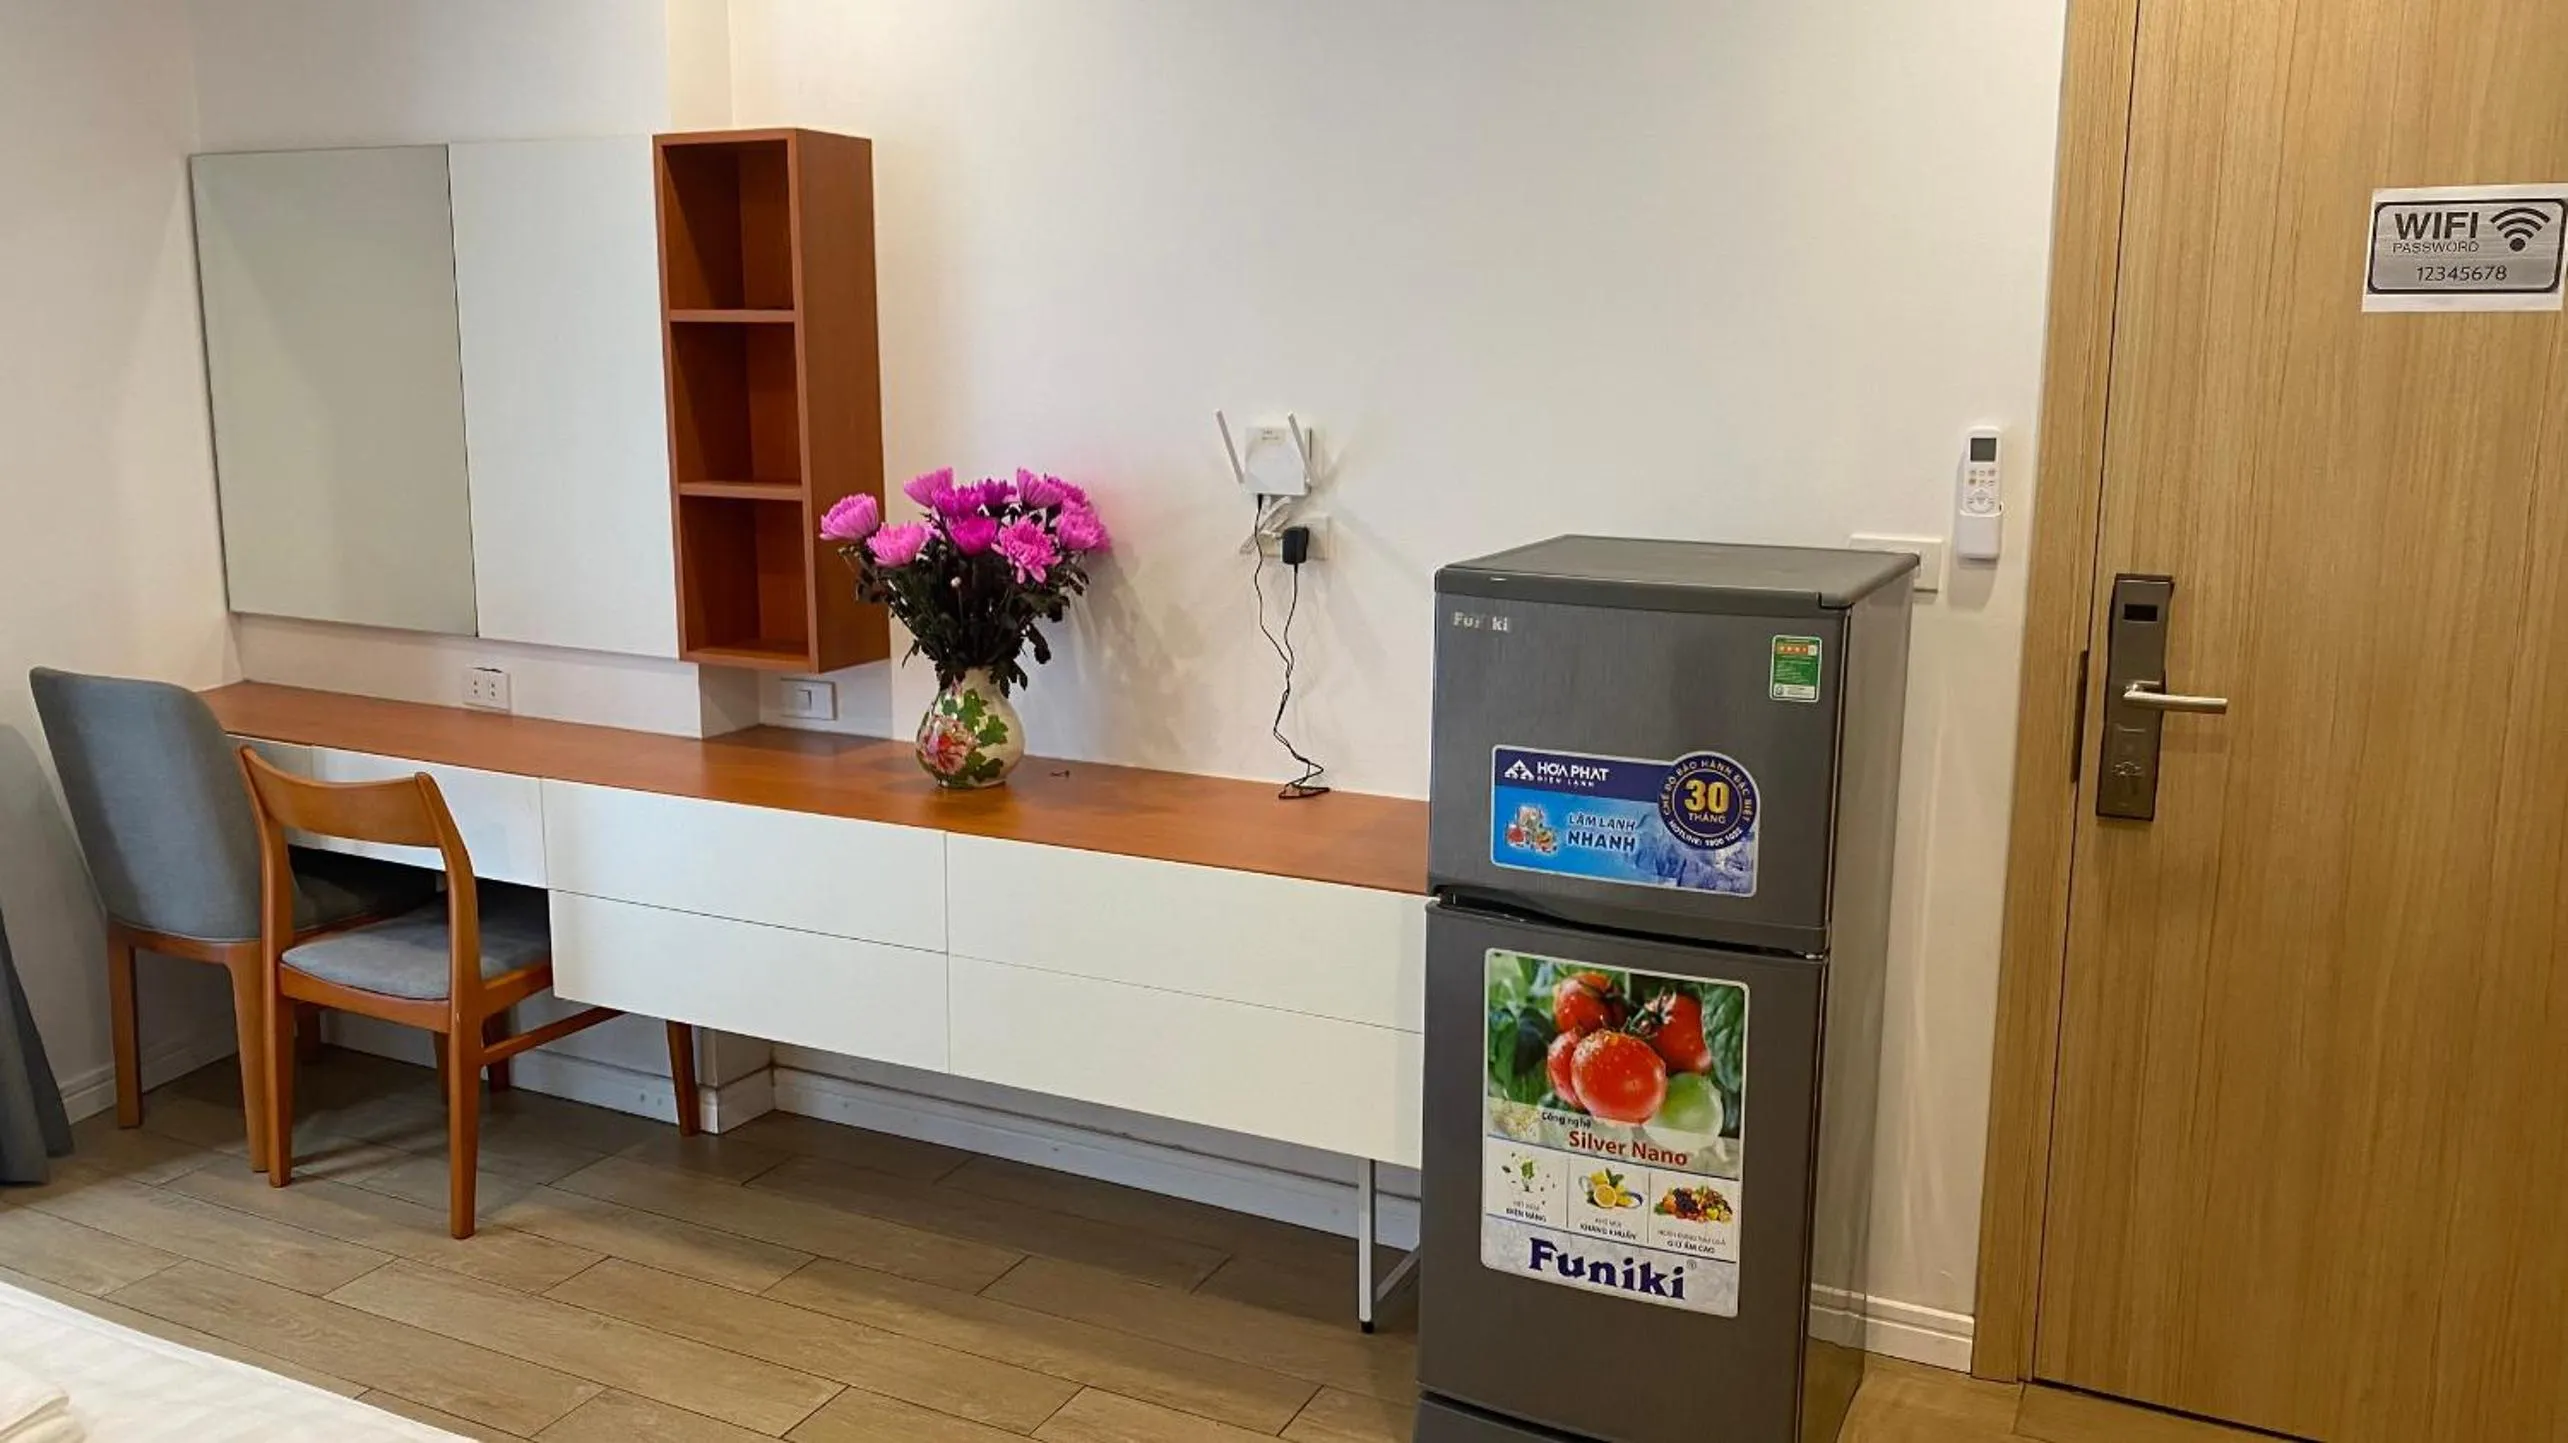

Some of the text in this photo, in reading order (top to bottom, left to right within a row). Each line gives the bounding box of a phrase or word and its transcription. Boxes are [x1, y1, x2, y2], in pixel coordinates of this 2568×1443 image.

[2394, 211, 2479, 241] WIFI
[2392, 241, 2480, 254] PASSWORD
[2417, 265, 2508, 282] 12345678
[1683, 779, 1730, 814] 30
[1567, 830, 1636, 853] NHANH
[1568, 1130, 1688, 1166] Silver Nano
[1529, 1236, 1685, 1300] Funiki
